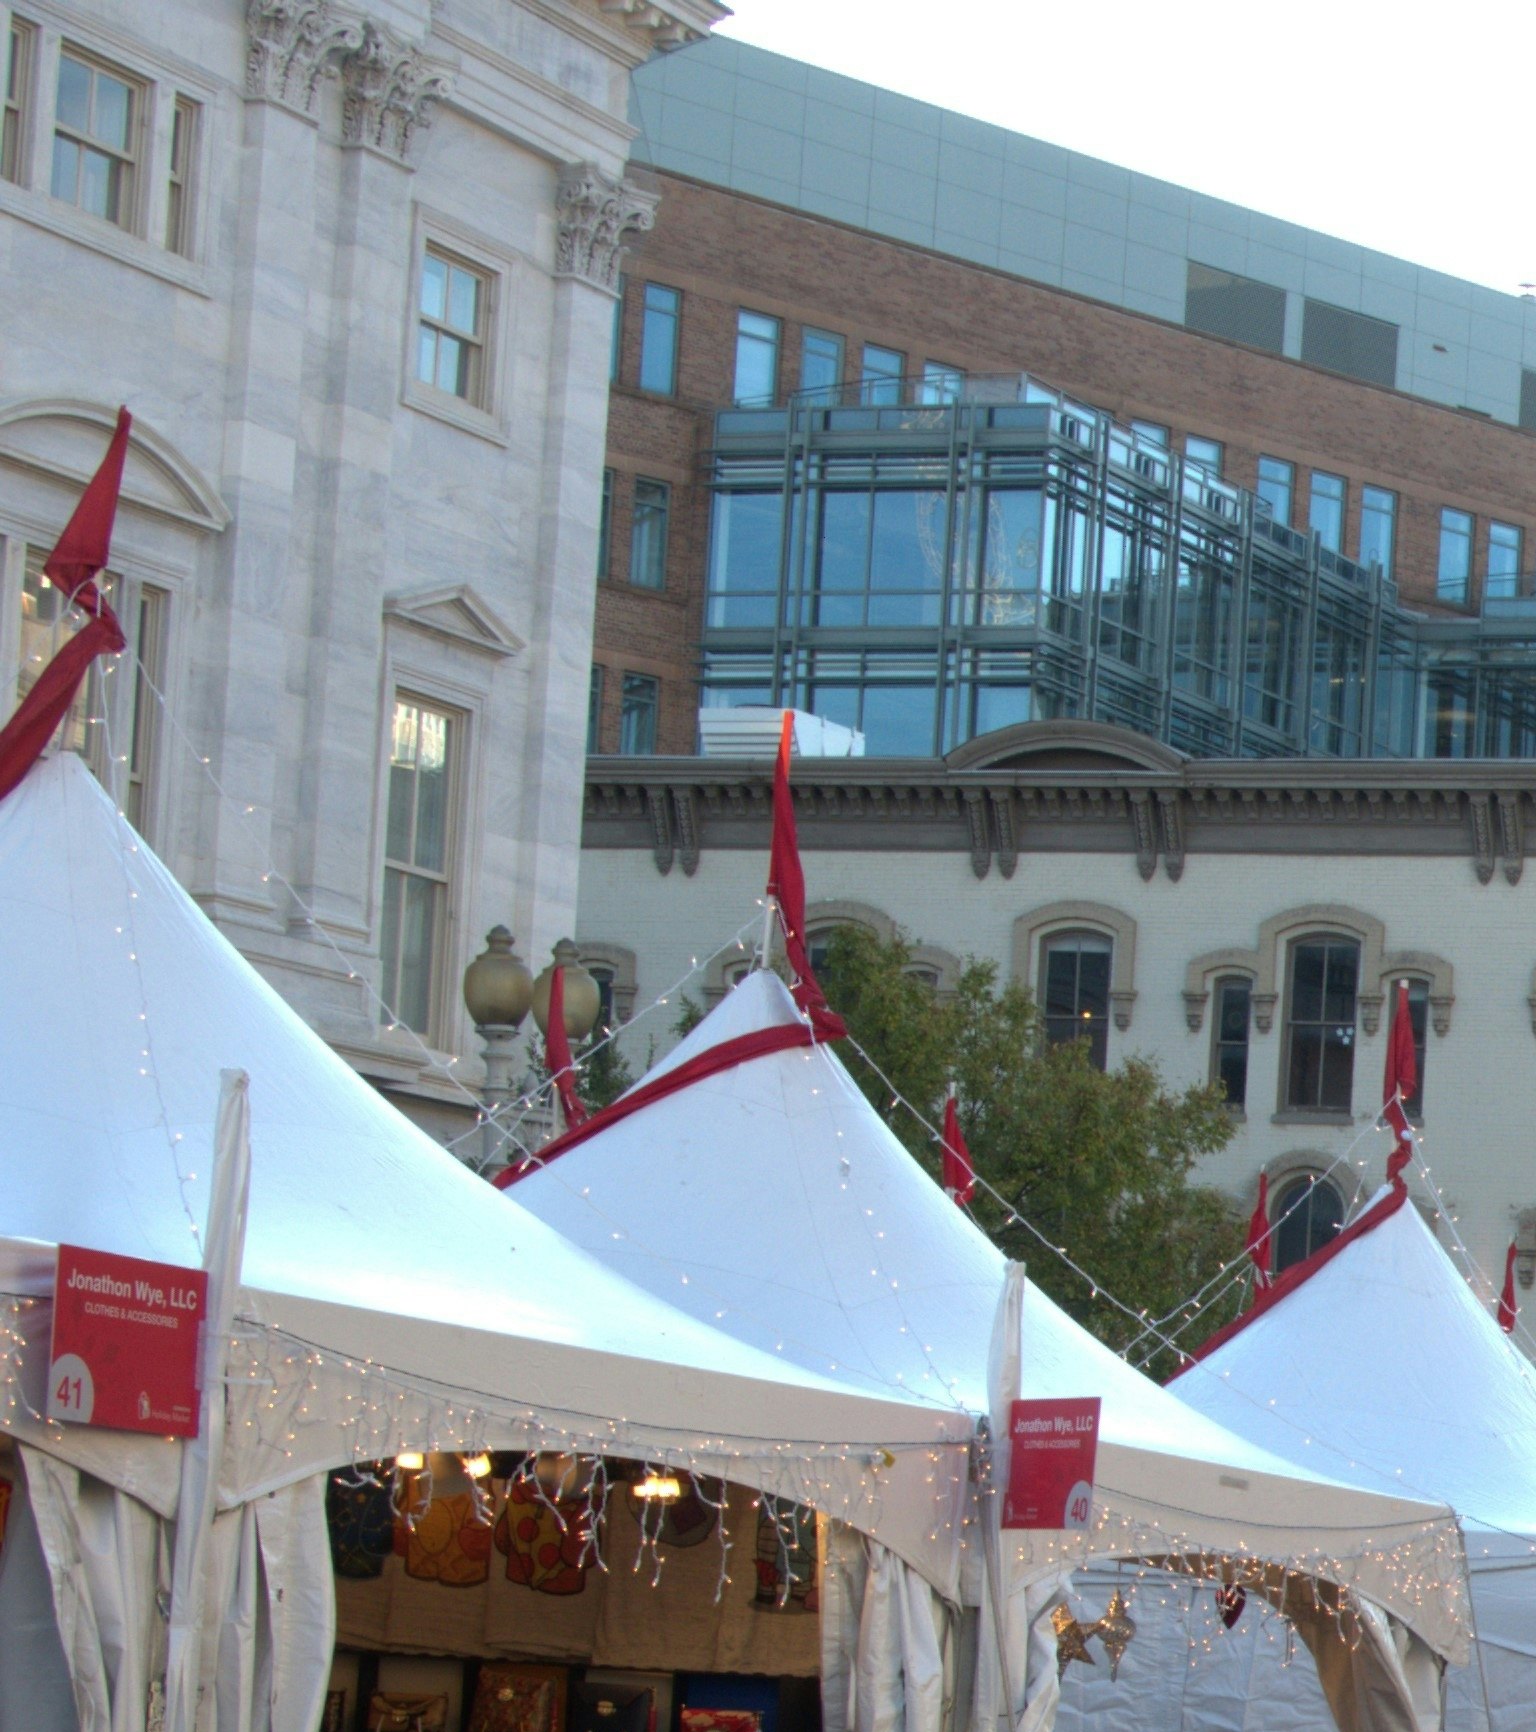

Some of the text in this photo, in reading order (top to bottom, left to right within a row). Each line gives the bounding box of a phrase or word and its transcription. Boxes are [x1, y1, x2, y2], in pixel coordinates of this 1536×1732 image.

[68, 1268, 198, 1310] Jonathon Wye, LLC
[84, 1301, 120, 1319] CLOTHES
[127, 1311, 178, 1328] ACCESSORIES
[56, 1375, 82, 1410] 41
[1014, 1416, 1094, 1435] Jonathon Wye, LLC
[1070, 1497, 1089, 1522] 40
